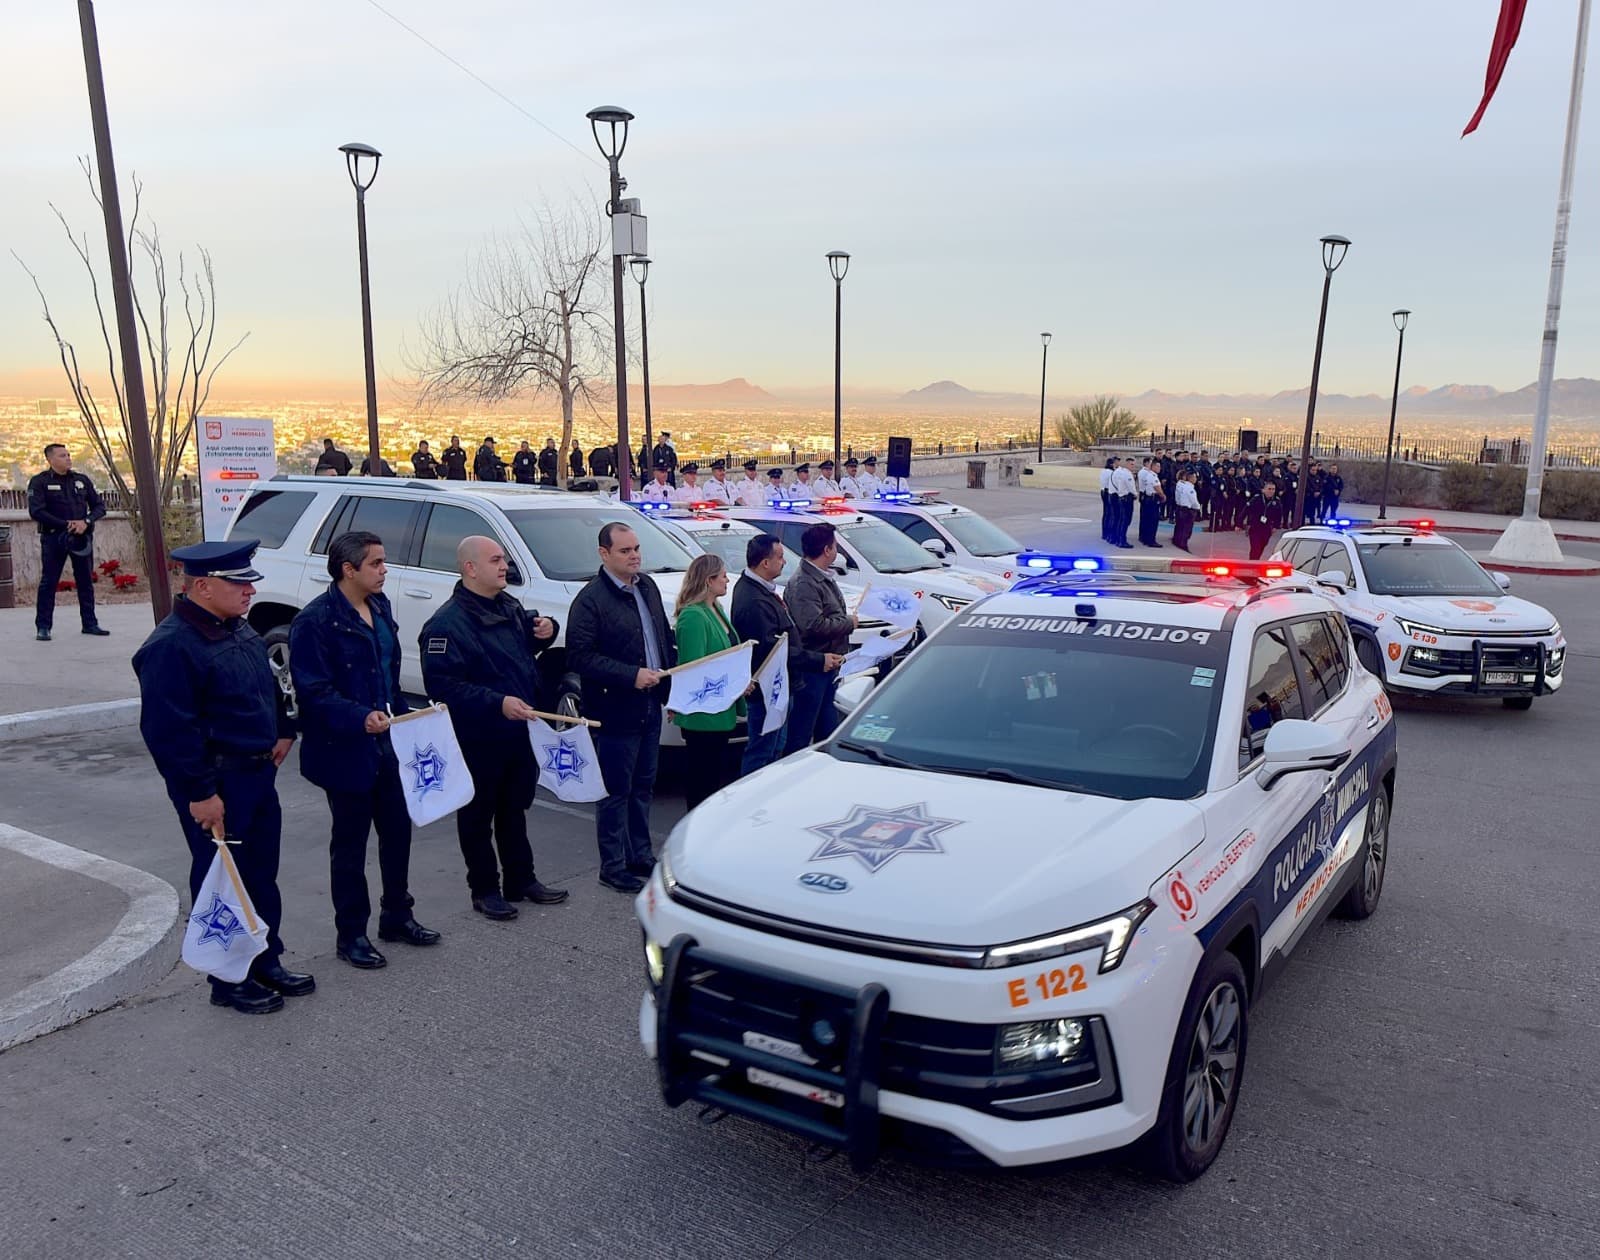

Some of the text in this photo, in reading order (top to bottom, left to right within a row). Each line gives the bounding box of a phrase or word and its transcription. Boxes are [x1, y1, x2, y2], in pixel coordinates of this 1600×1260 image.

[1412, 632, 1438, 645] E 139
[1273, 820, 1317, 904] POLICÍA
[801, 873, 848, 890] JAC
[1007, 963, 1088, 1008] E 122
